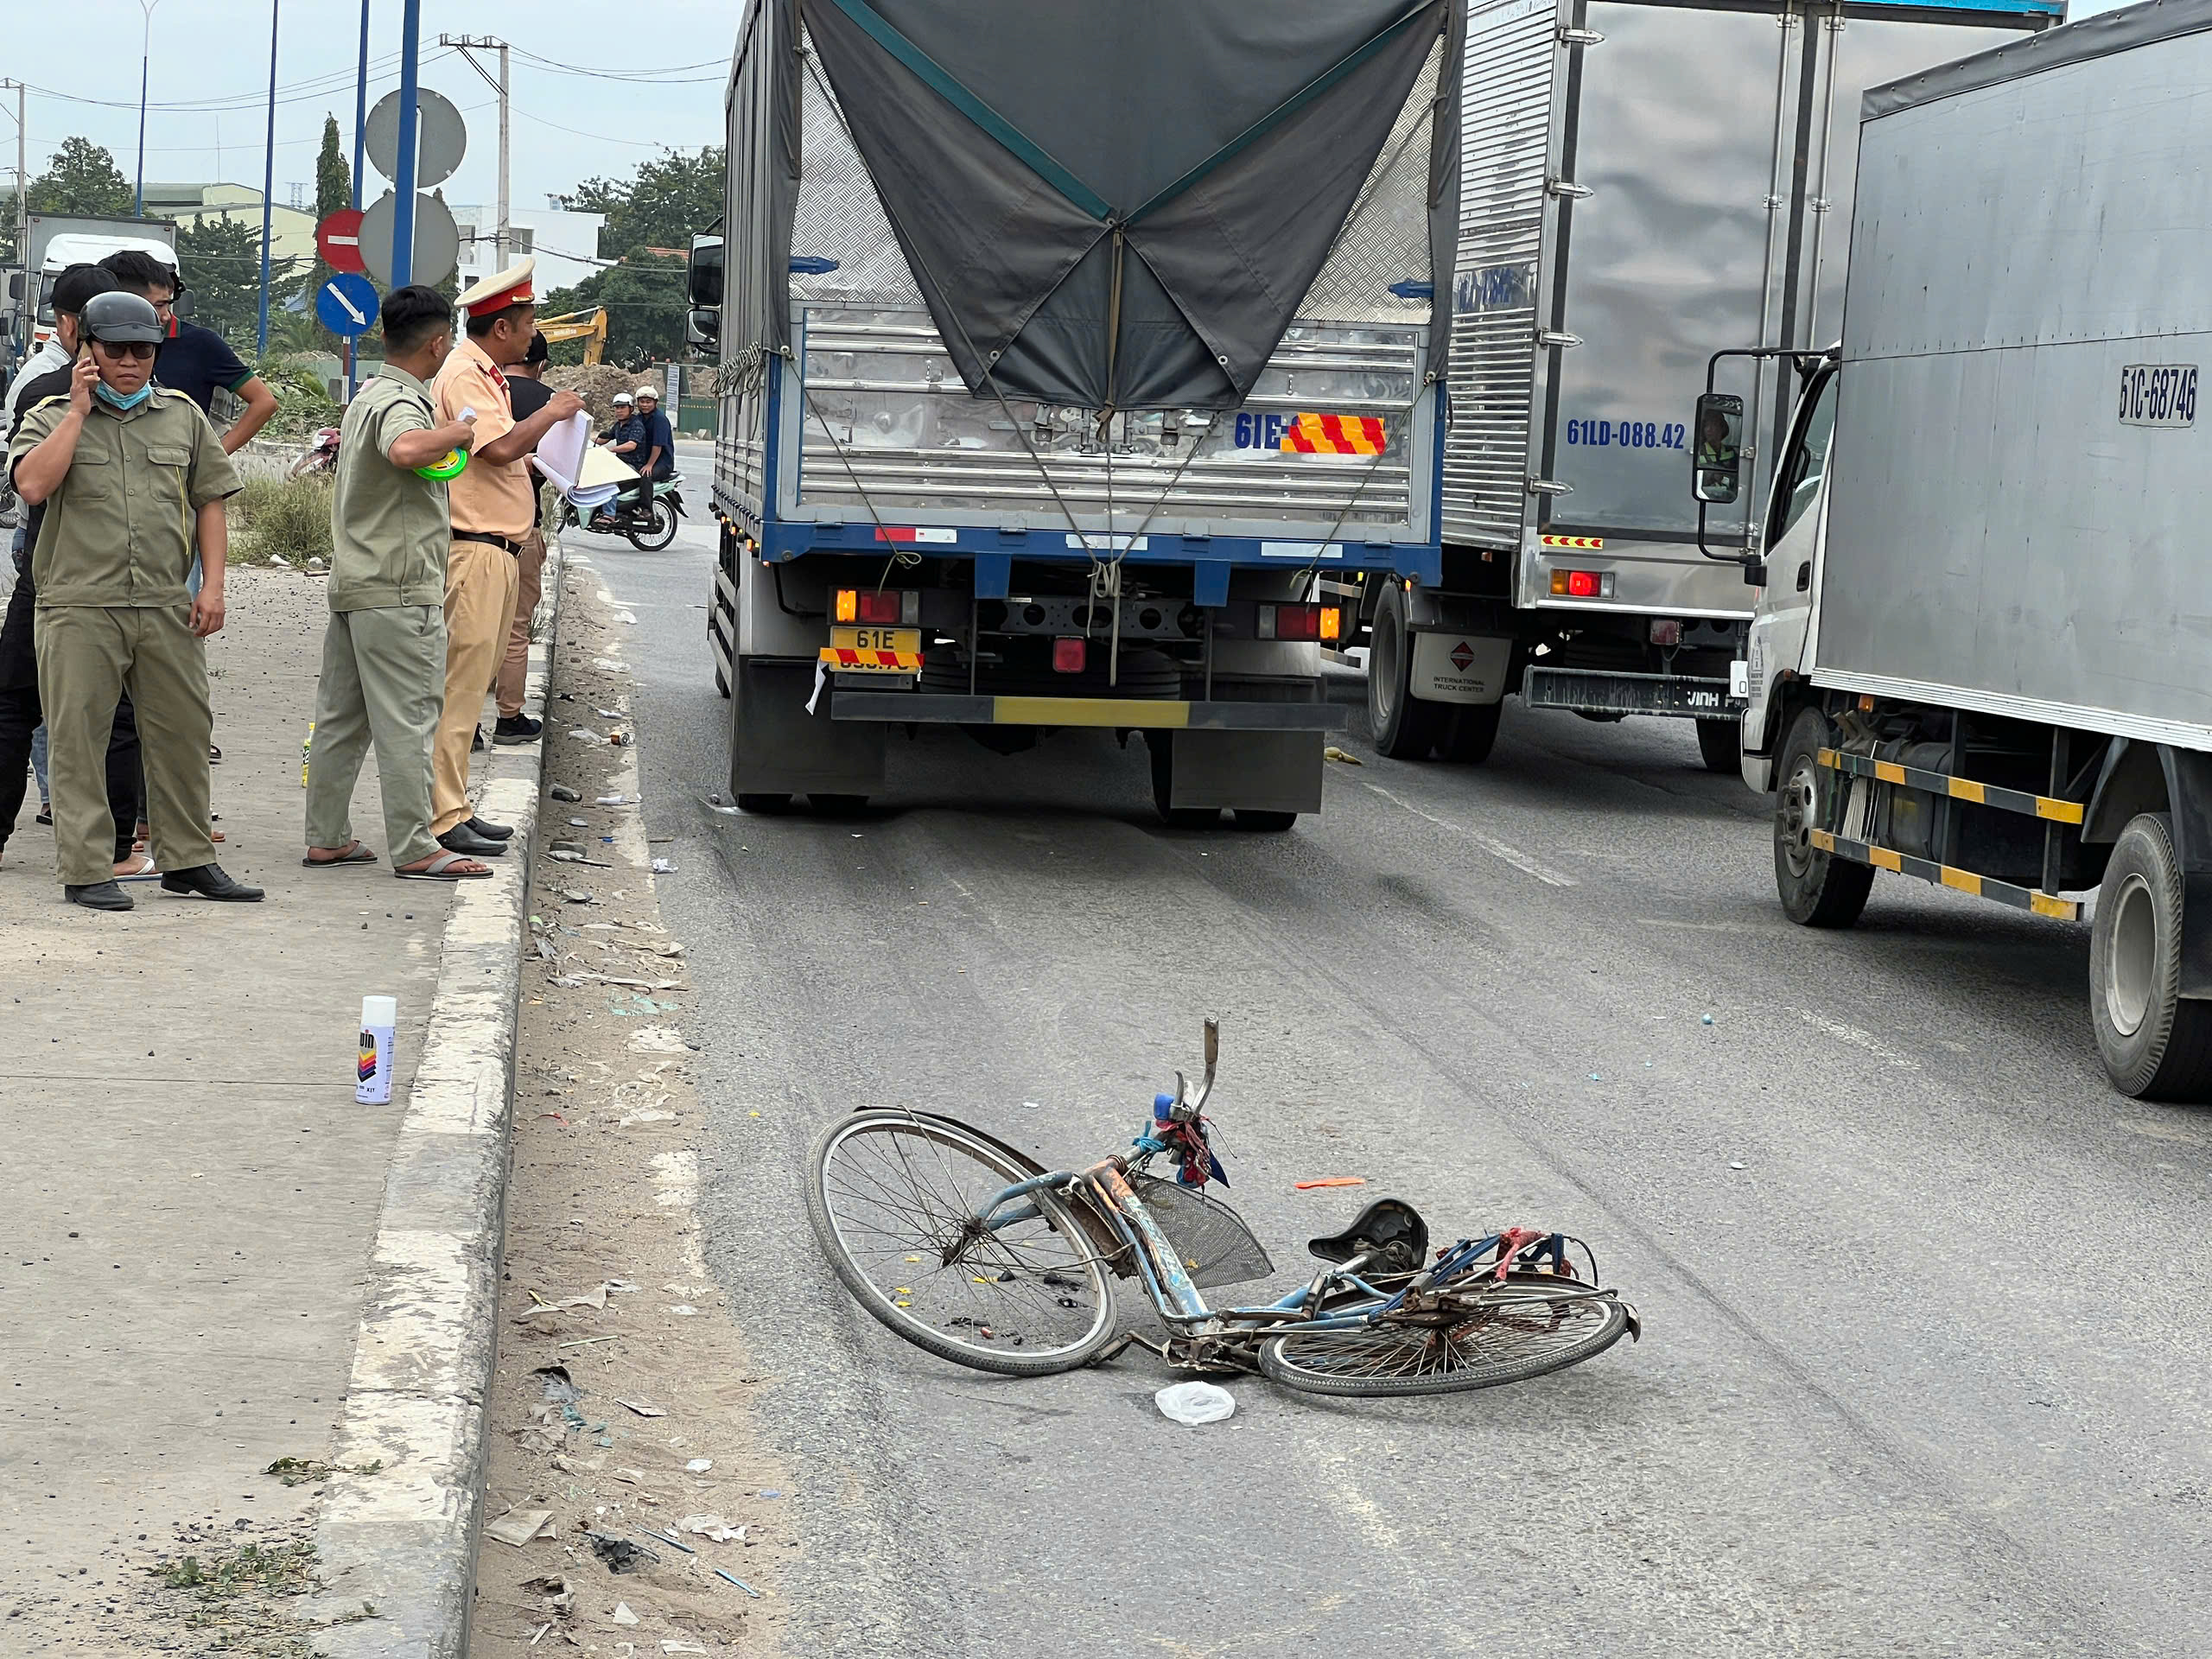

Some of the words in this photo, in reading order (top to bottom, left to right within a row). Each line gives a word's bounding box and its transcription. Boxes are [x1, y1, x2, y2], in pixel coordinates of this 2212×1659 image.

[2120, 368, 2196, 421] 51C-68746
[1567, 419, 1685, 449] 61LD-088.42
[857, 630, 894, 649] 61E
[1433, 676, 1485, 686] INTERNATIONAL
[1434, 683, 1457, 691] TRUCK
